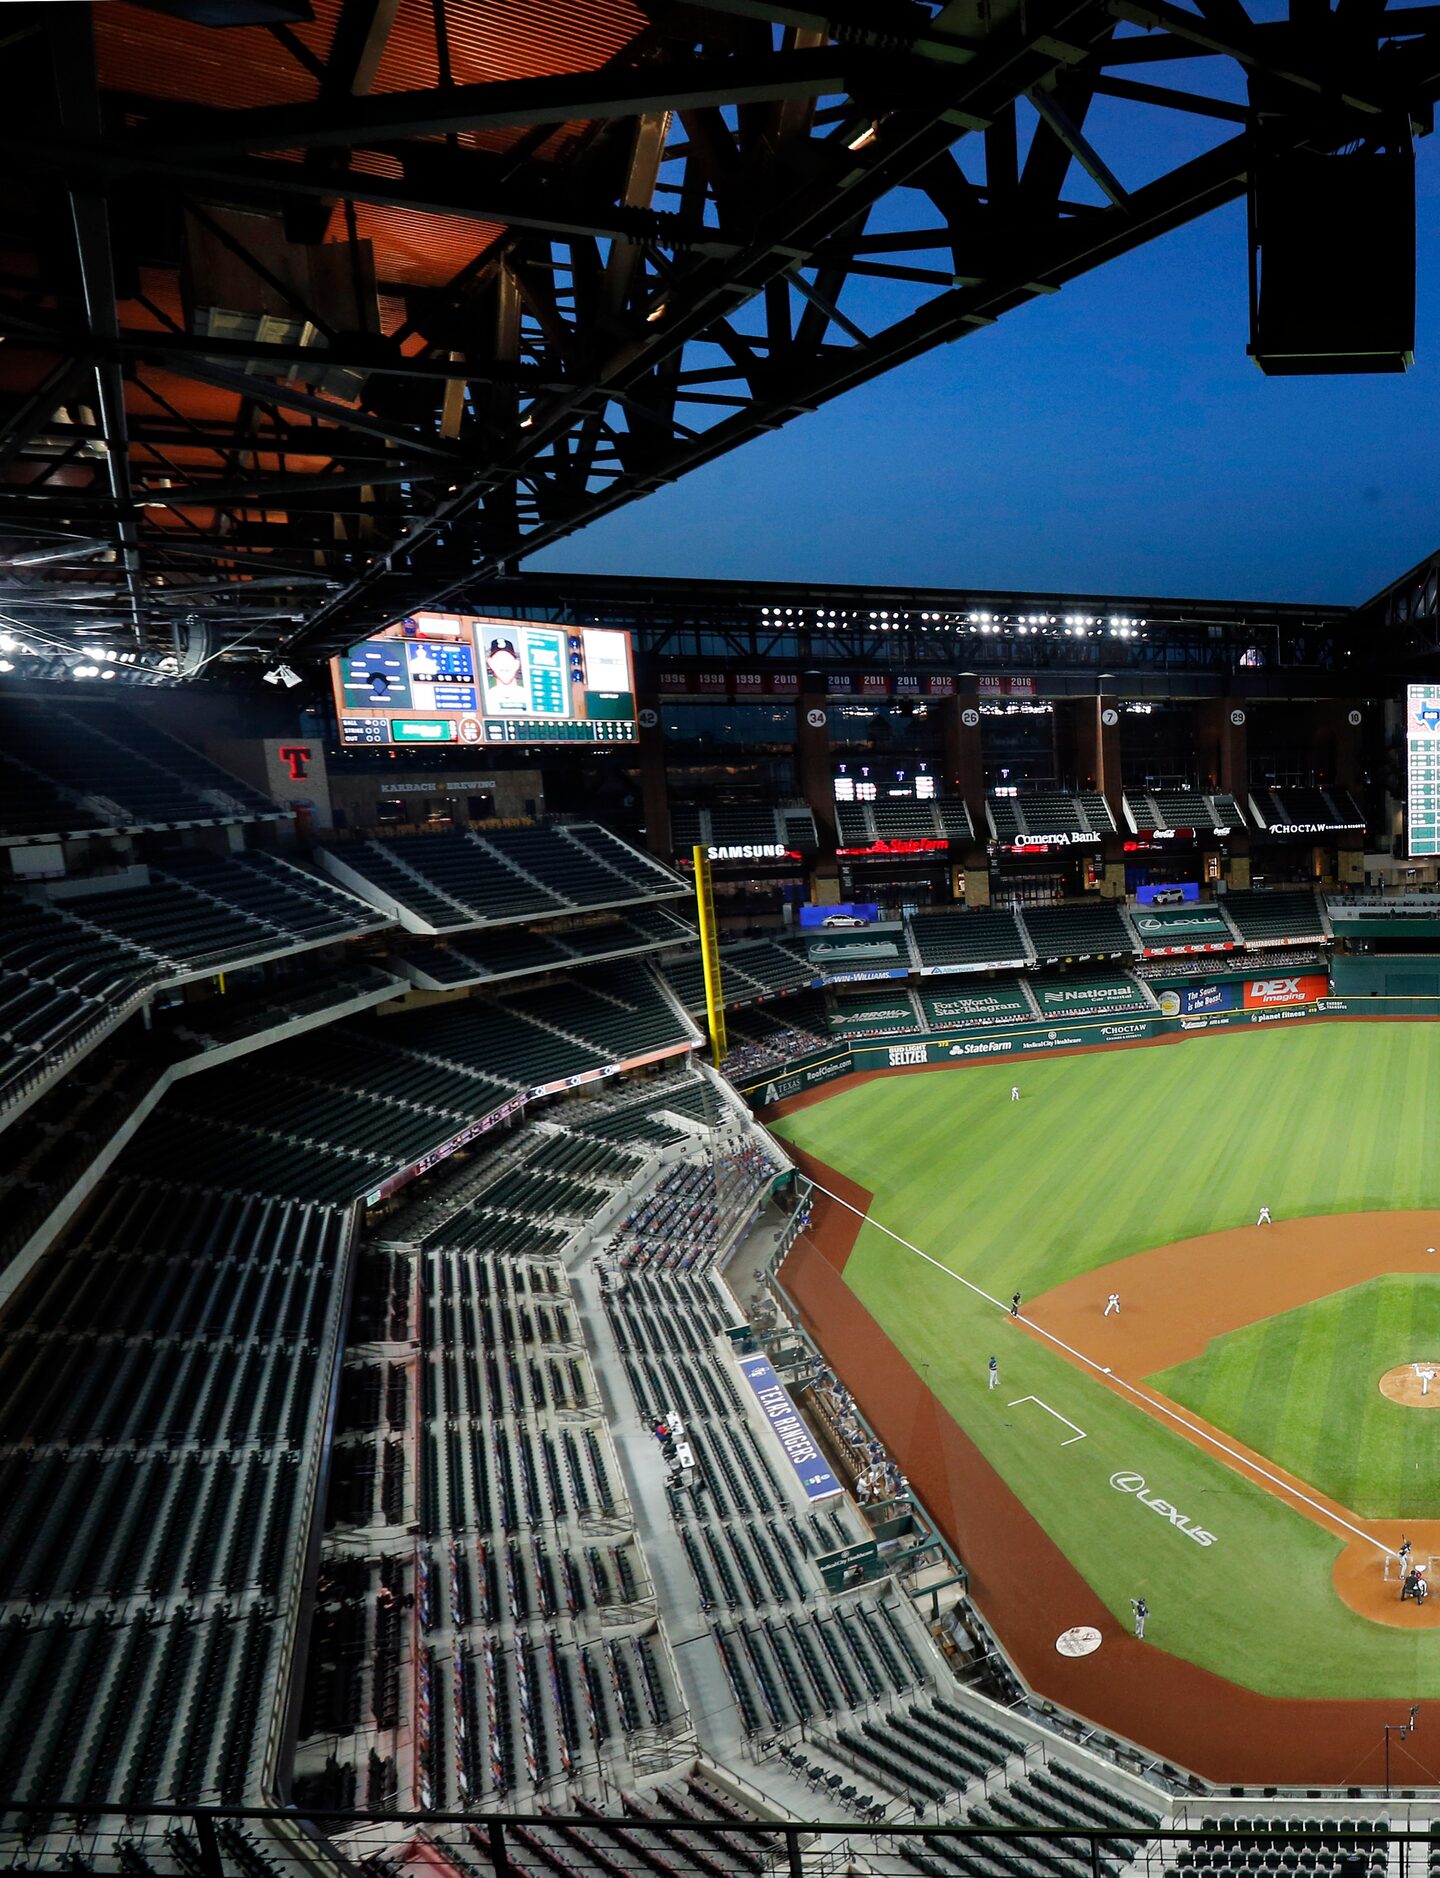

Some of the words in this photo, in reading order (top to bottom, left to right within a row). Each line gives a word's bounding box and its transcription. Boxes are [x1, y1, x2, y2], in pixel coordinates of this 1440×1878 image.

[659, 674, 685, 684] 1996
[699, 674, 725, 684] 1998
[736, 674, 761, 684] 1999
[774, 675, 797, 684] 2010
[828, 675, 850, 685] 2010
[864, 676, 884, 685] 2011
[897, 676, 918, 686] 2011
[931, 676, 952, 686] 2012
[979, 676, 1000, 686] 2015
[1011, 677, 1031, 686] 2016
[639, 712, 656, 725] 42
[809, 713, 824, 724] 34
[964, 713, 977, 723] 26
[1106, 713, 1114, 722] 7
[1232, 713, 1245, 723] 29
[1350, 713, 1359, 723] 10
[279, 745, 312, 781] T
[380, 782, 436, 793] KARBACH
[446, 781, 496, 790] BREWING
[1152, 829, 1175, 839] Coca-Cola
[1213, 827, 1231, 836] Coca-Cola
[1276, 823, 1326, 834] CHOCTAW
[1072, 831, 1101, 843] Bank
[707, 844, 785, 860] SAMSUNG
[1161, 917, 1221, 927] LEXUS
[1245, 938, 1284, 949] WHATABURGER
[1287, 935, 1327, 946] WHATABURGER
[1151, 947, 1168, 955] DEX
[1171, 945, 1187, 953] DEX
[1191, 944, 1206, 952] DEX
[1210, 943, 1226, 951] DEX
[1187, 991, 1199, 1000] The
[1199, 985, 1217, 997] Sauce
[1250, 977, 1301, 998] DEX
[1105, 993, 1132, 1001] Rental
[1187, 1003, 1194, 1012] is
[1194, 999, 1204, 1010] the
[1205, 993, 1222, 1007] Boss!
[1262, 992, 1306, 1003] imaging
[932, 1000, 959, 1010] Fort
[959, 997, 999, 1007] Worth
[935, 1001, 1022, 1017] Star-Telegram
[848, 1009, 904, 1020] ARROW
[1258, 1013, 1281, 1023] planet
[1281, 1010, 1306, 1019] fitness
[1105, 1024, 1147, 1035] CHOCTAW
[1022, 1041, 1043, 1049] Medical
[1042, 1040, 1054, 1048] City
[1054, 1038, 1082, 1046] Healthcare
[888, 1047, 906, 1055] BUD
[906, 1044, 926, 1054] LIGHT
[888, 1051, 928, 1066] SELTZER
[806, 1059, 852, 1081] RoofClaim.com
[777, 1078, 801, 1093] TEXAS
[757, 1384, 792, 1418] TEXAS
[773, 1415, 817, 1464] RANGERS
[1136, 1489, 1218, 1547] LEXUS
